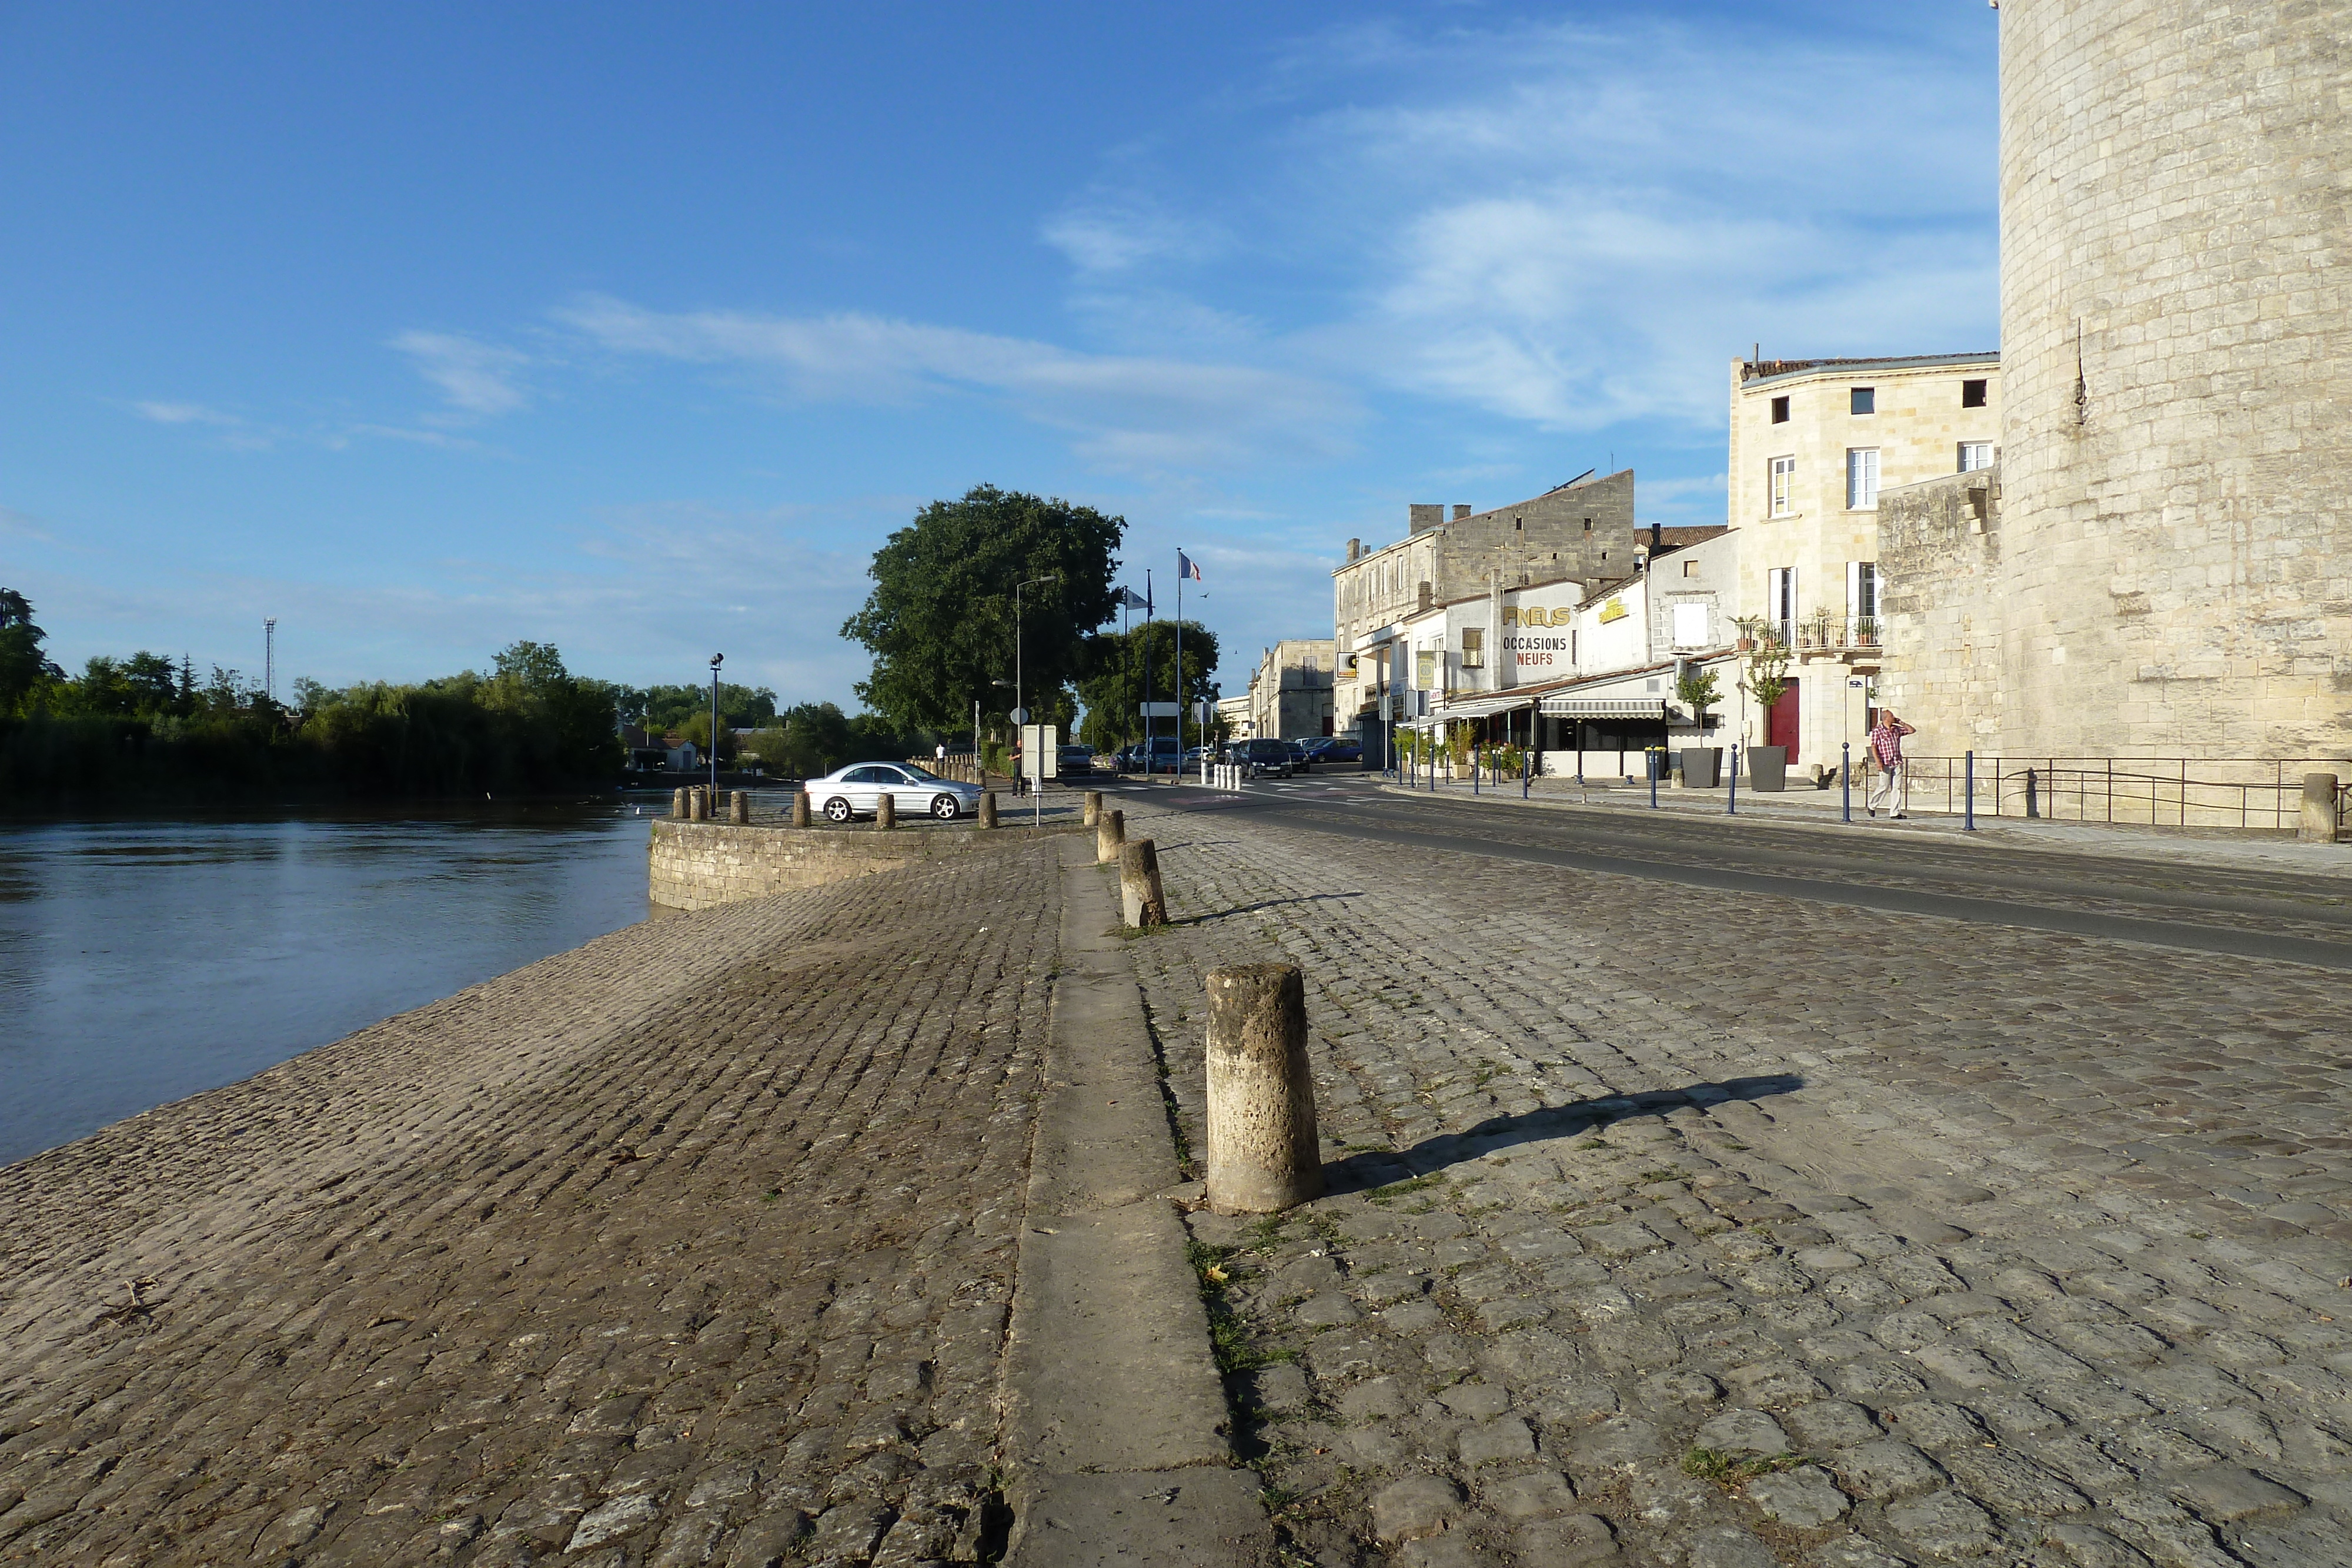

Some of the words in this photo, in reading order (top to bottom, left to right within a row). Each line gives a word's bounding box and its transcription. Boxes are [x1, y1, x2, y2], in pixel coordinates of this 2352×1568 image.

[1504, 606, 1570, 628] PNEUS
[1504, 637, 1566, 650] OCCASIONS
[1517, 653, 1552, 665] NEUFS
